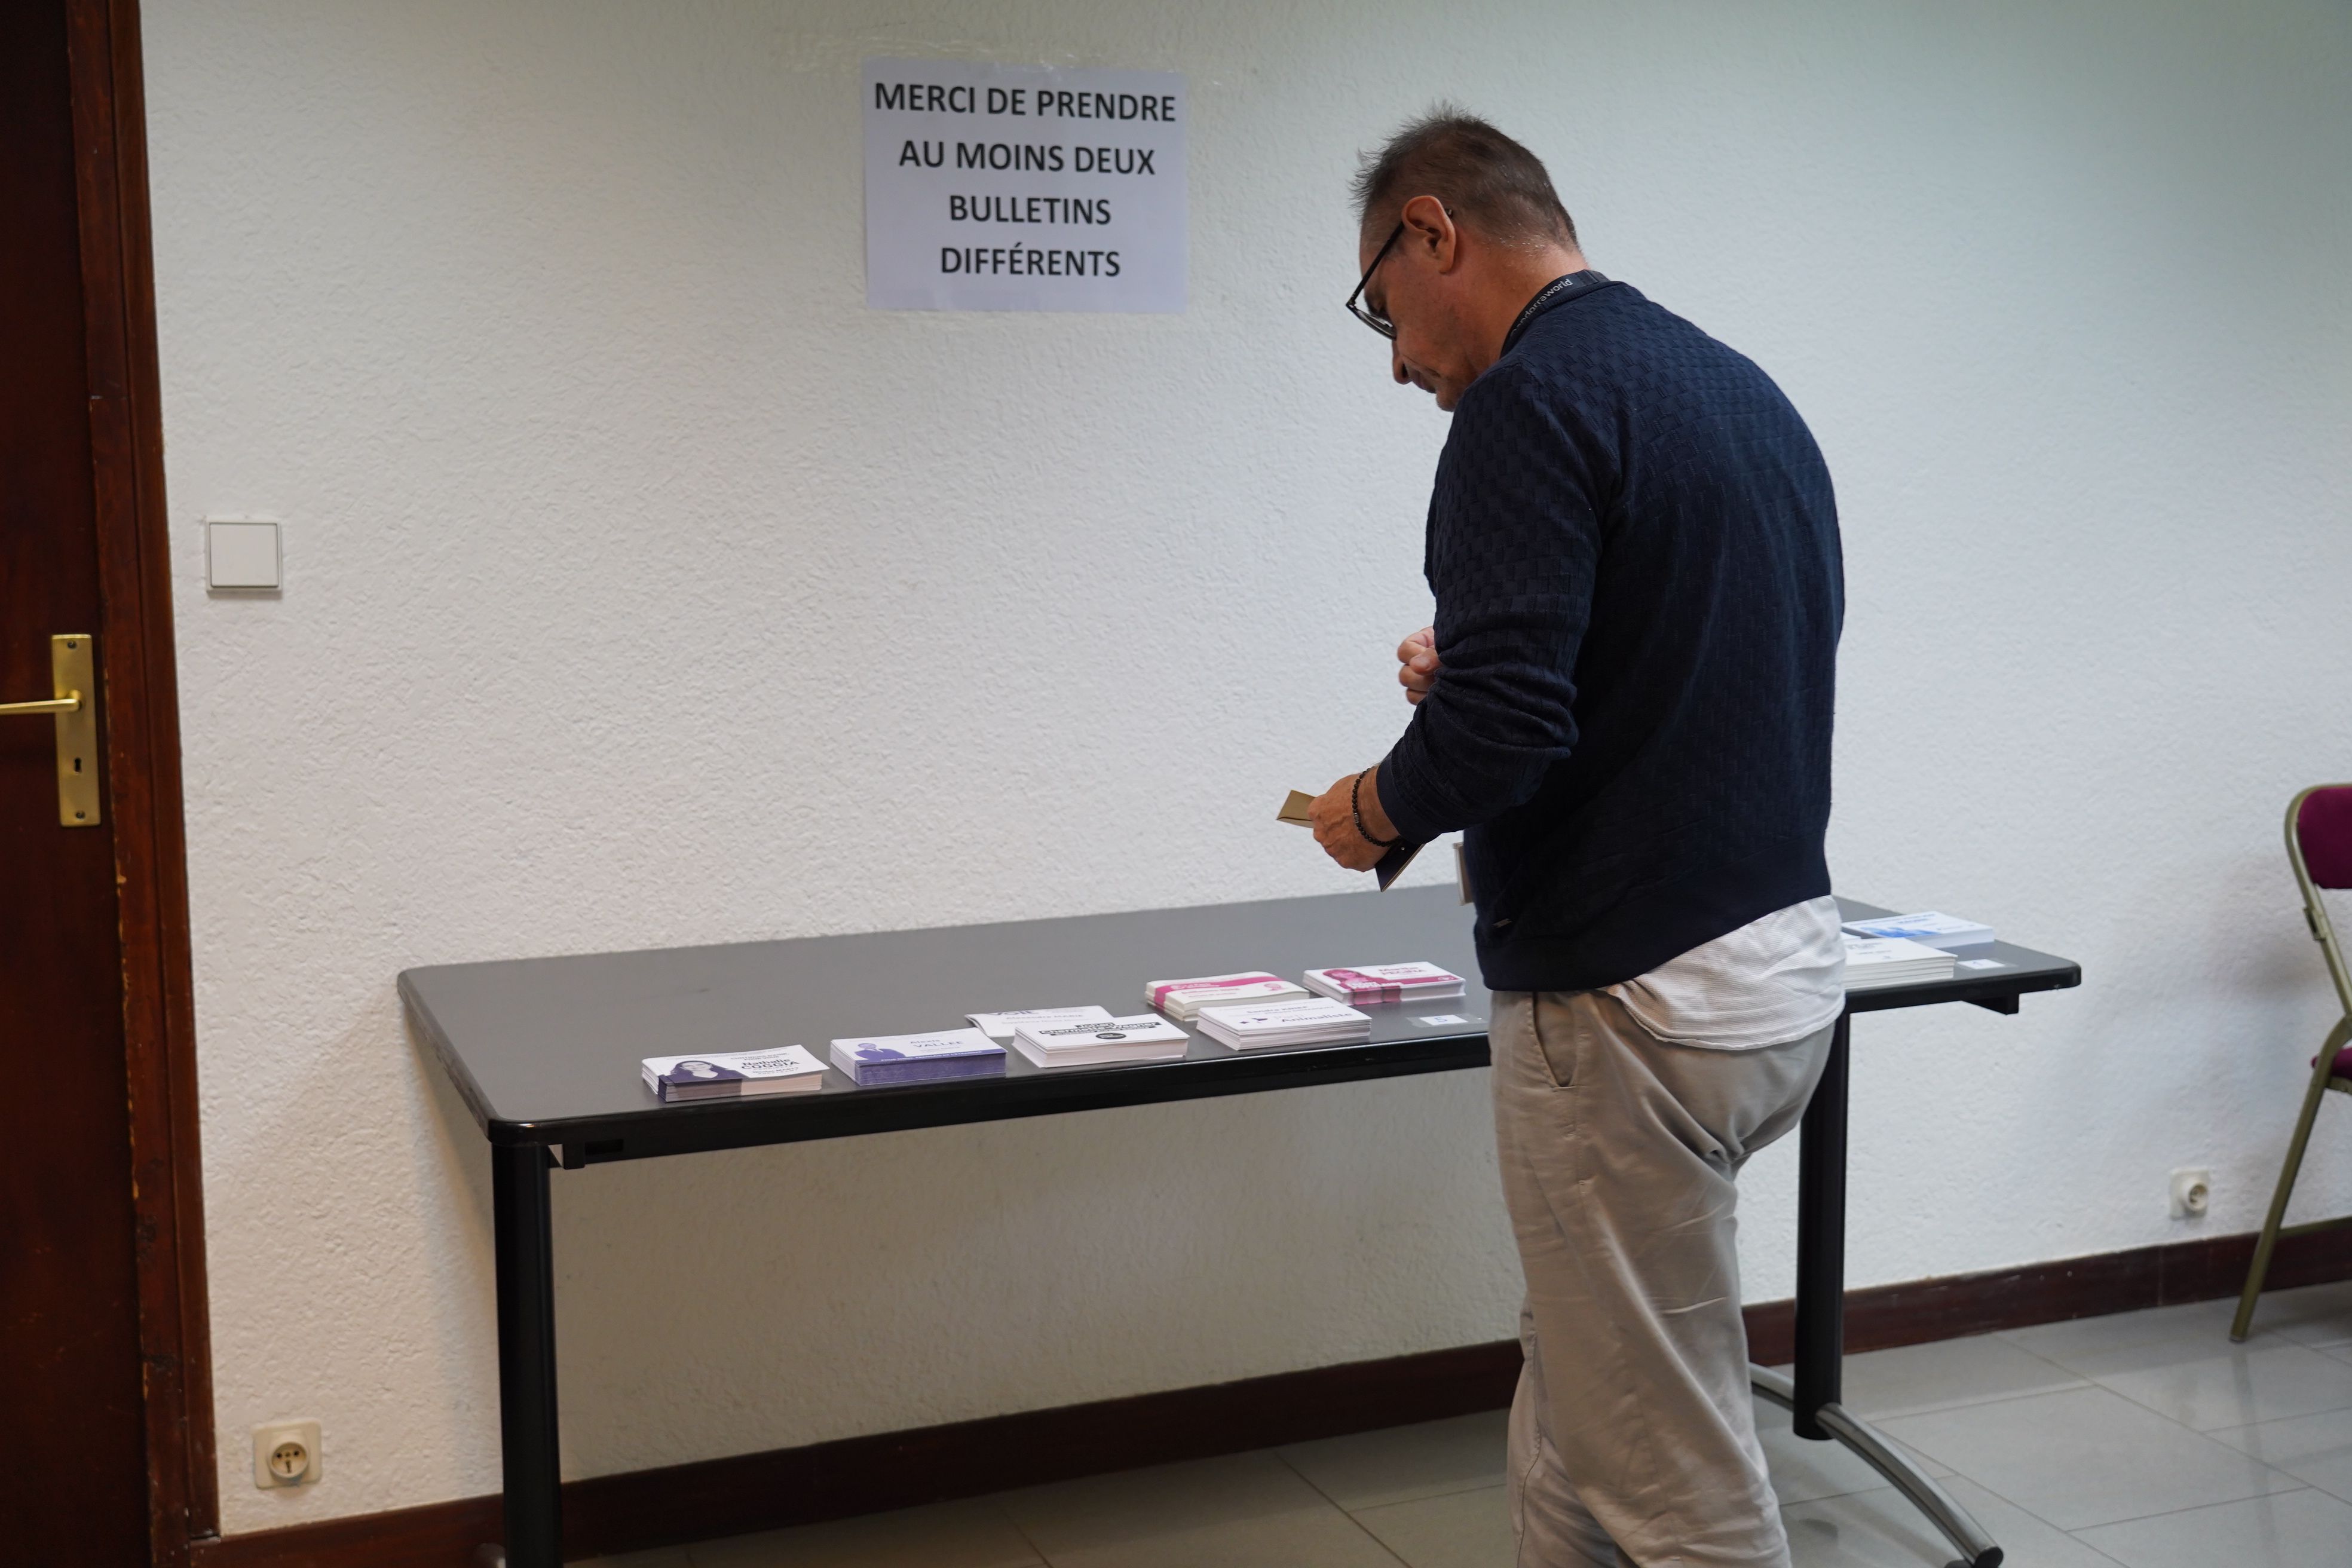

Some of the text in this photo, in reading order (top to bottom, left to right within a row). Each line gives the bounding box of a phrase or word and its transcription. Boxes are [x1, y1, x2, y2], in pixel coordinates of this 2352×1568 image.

[875, 82, 1176, 122] MERCI DE PRENDRE
[899, 140, 1155, 174] AU MOINS DEUX
[950, 195, 1111, 225] BULLETINS
[941, 242, 1120, 277] DIFFÉRENTS
[1281, 1013, 1353, 1022] Animaliste
[741, 1061, 801, 1070] COGGIA
